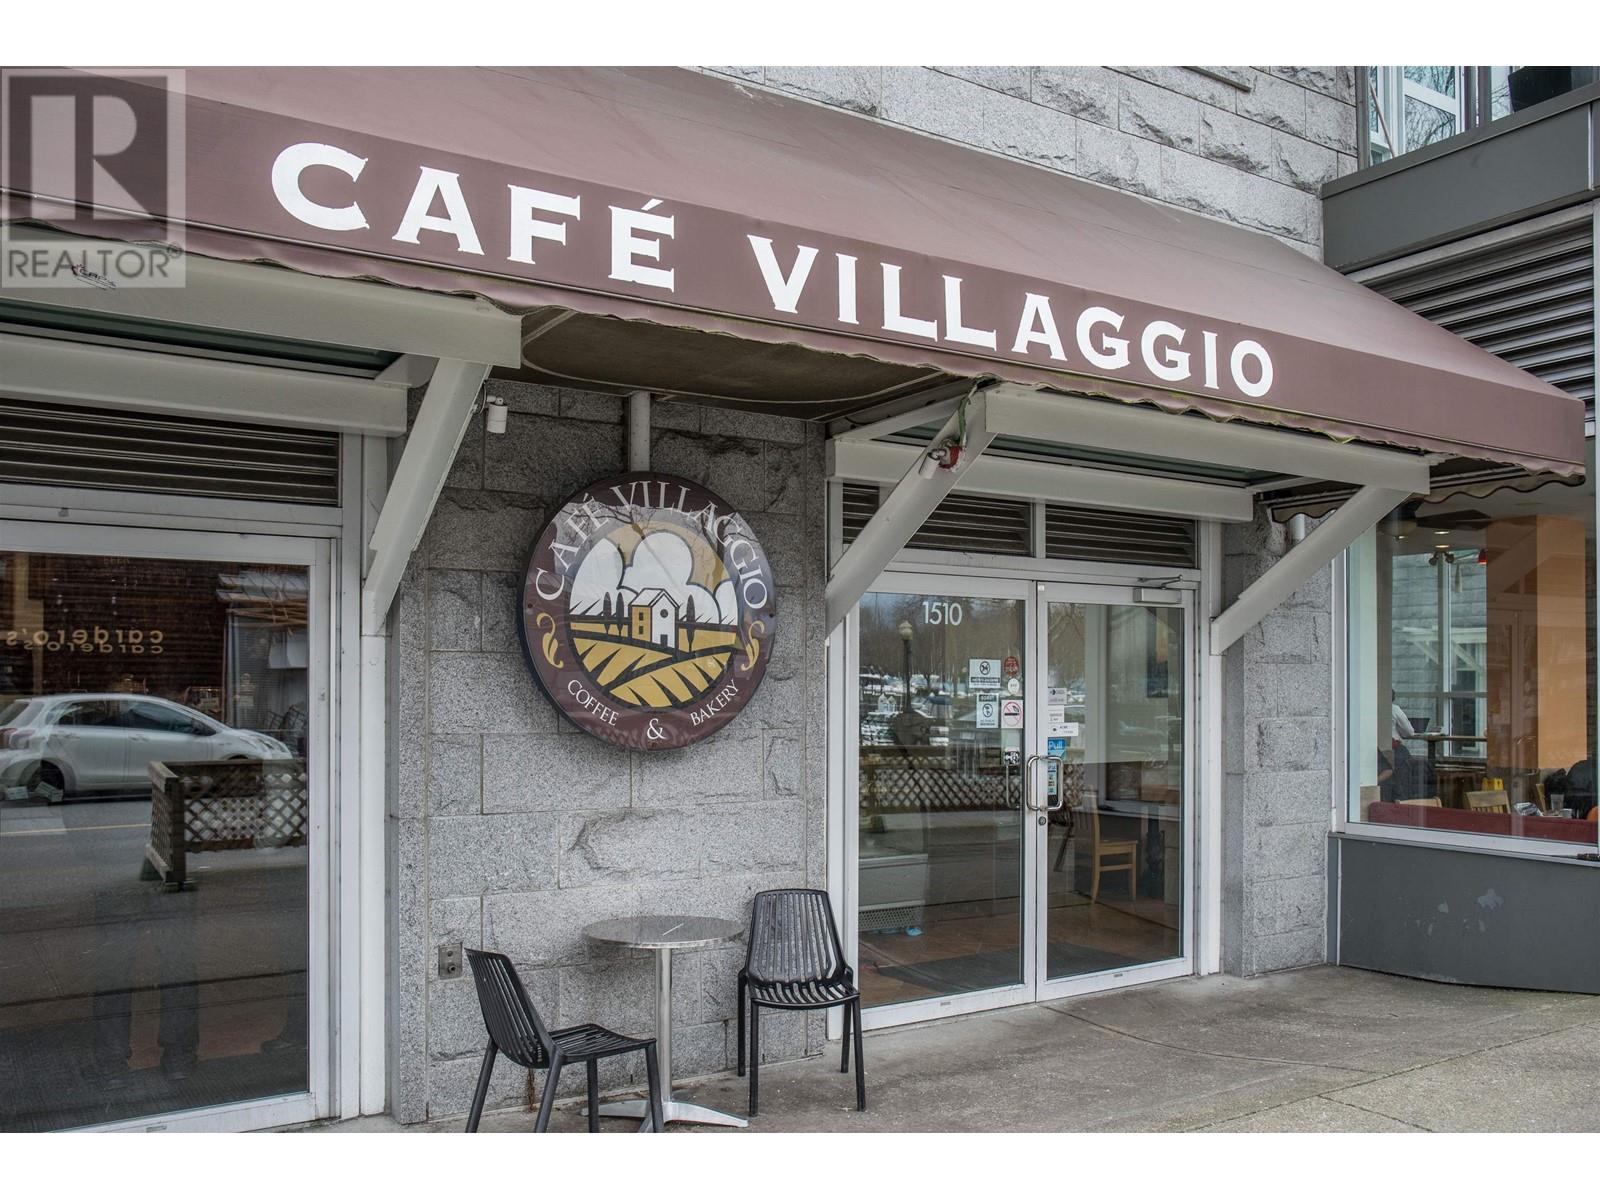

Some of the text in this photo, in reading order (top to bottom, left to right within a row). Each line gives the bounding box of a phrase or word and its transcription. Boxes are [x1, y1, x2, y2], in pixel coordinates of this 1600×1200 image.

[271, 142, 1274, 398] CAFÉ VILLAGGIO
[535, 480, 768, 610] CAFÉ VILLAGGIO
[922, 601, 963, 626] 1510
[567, 679, 740, 740] COFFEE & BAKERY
[1048, 740, 1063, 750] Pull
